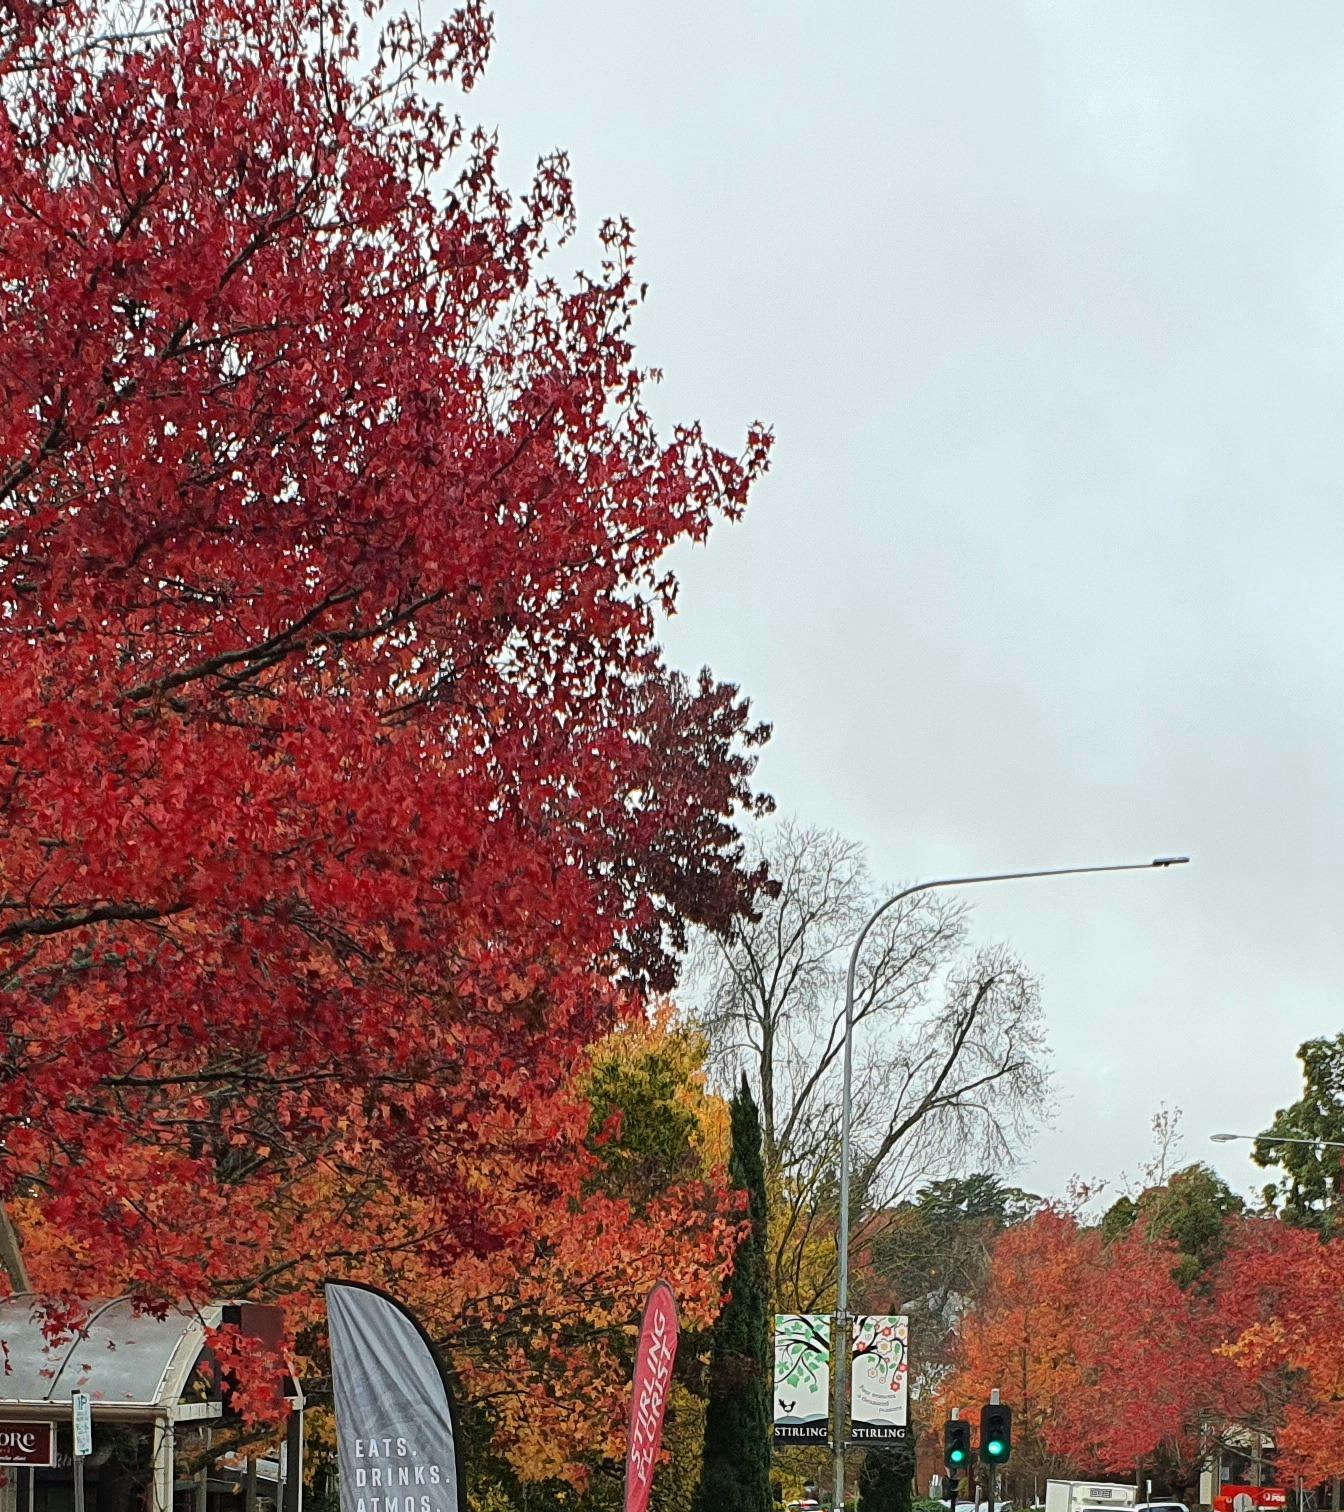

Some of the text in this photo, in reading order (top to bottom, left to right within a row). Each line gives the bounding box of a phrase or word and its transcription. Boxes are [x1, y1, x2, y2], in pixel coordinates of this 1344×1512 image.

[631, 1308, 667, 1470] STIRLING
[637, 1333, 672, 1487] FLORIST
[774, 1427, 828, 1438] STIRLING
[851, 1428, 906, 1439] STIRLING
[356, 1437, 417, 1458] EATS.
[356, 1465, 450, 1487] DRINKS.
